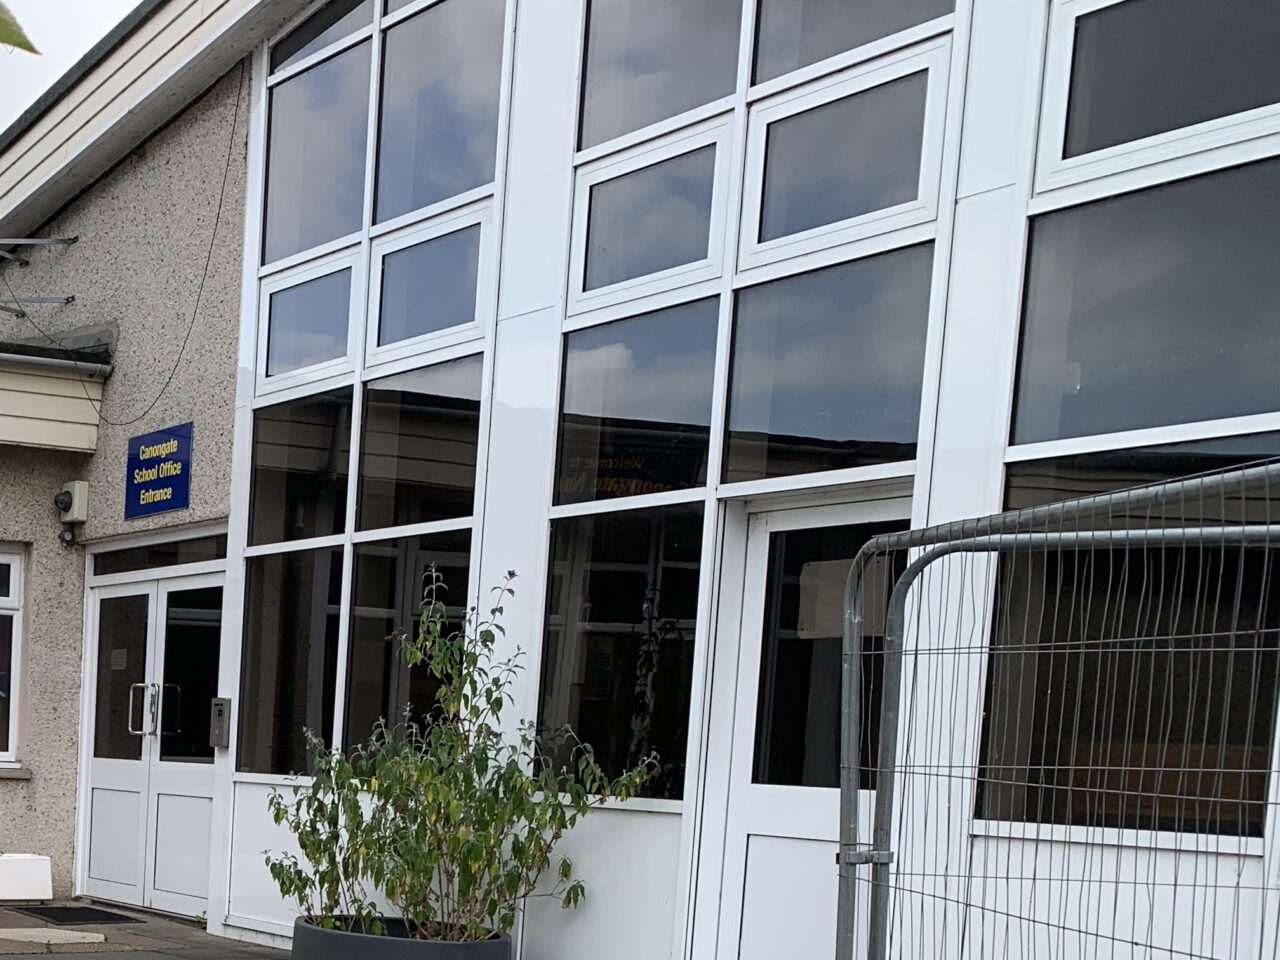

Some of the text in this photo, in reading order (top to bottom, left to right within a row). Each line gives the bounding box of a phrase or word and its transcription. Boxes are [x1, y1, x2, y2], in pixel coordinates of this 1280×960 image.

[140, 438, 178, 460] Canongate
[134, 461, 182, 484] School Office
[140, 486, 172, 505] Entrance
